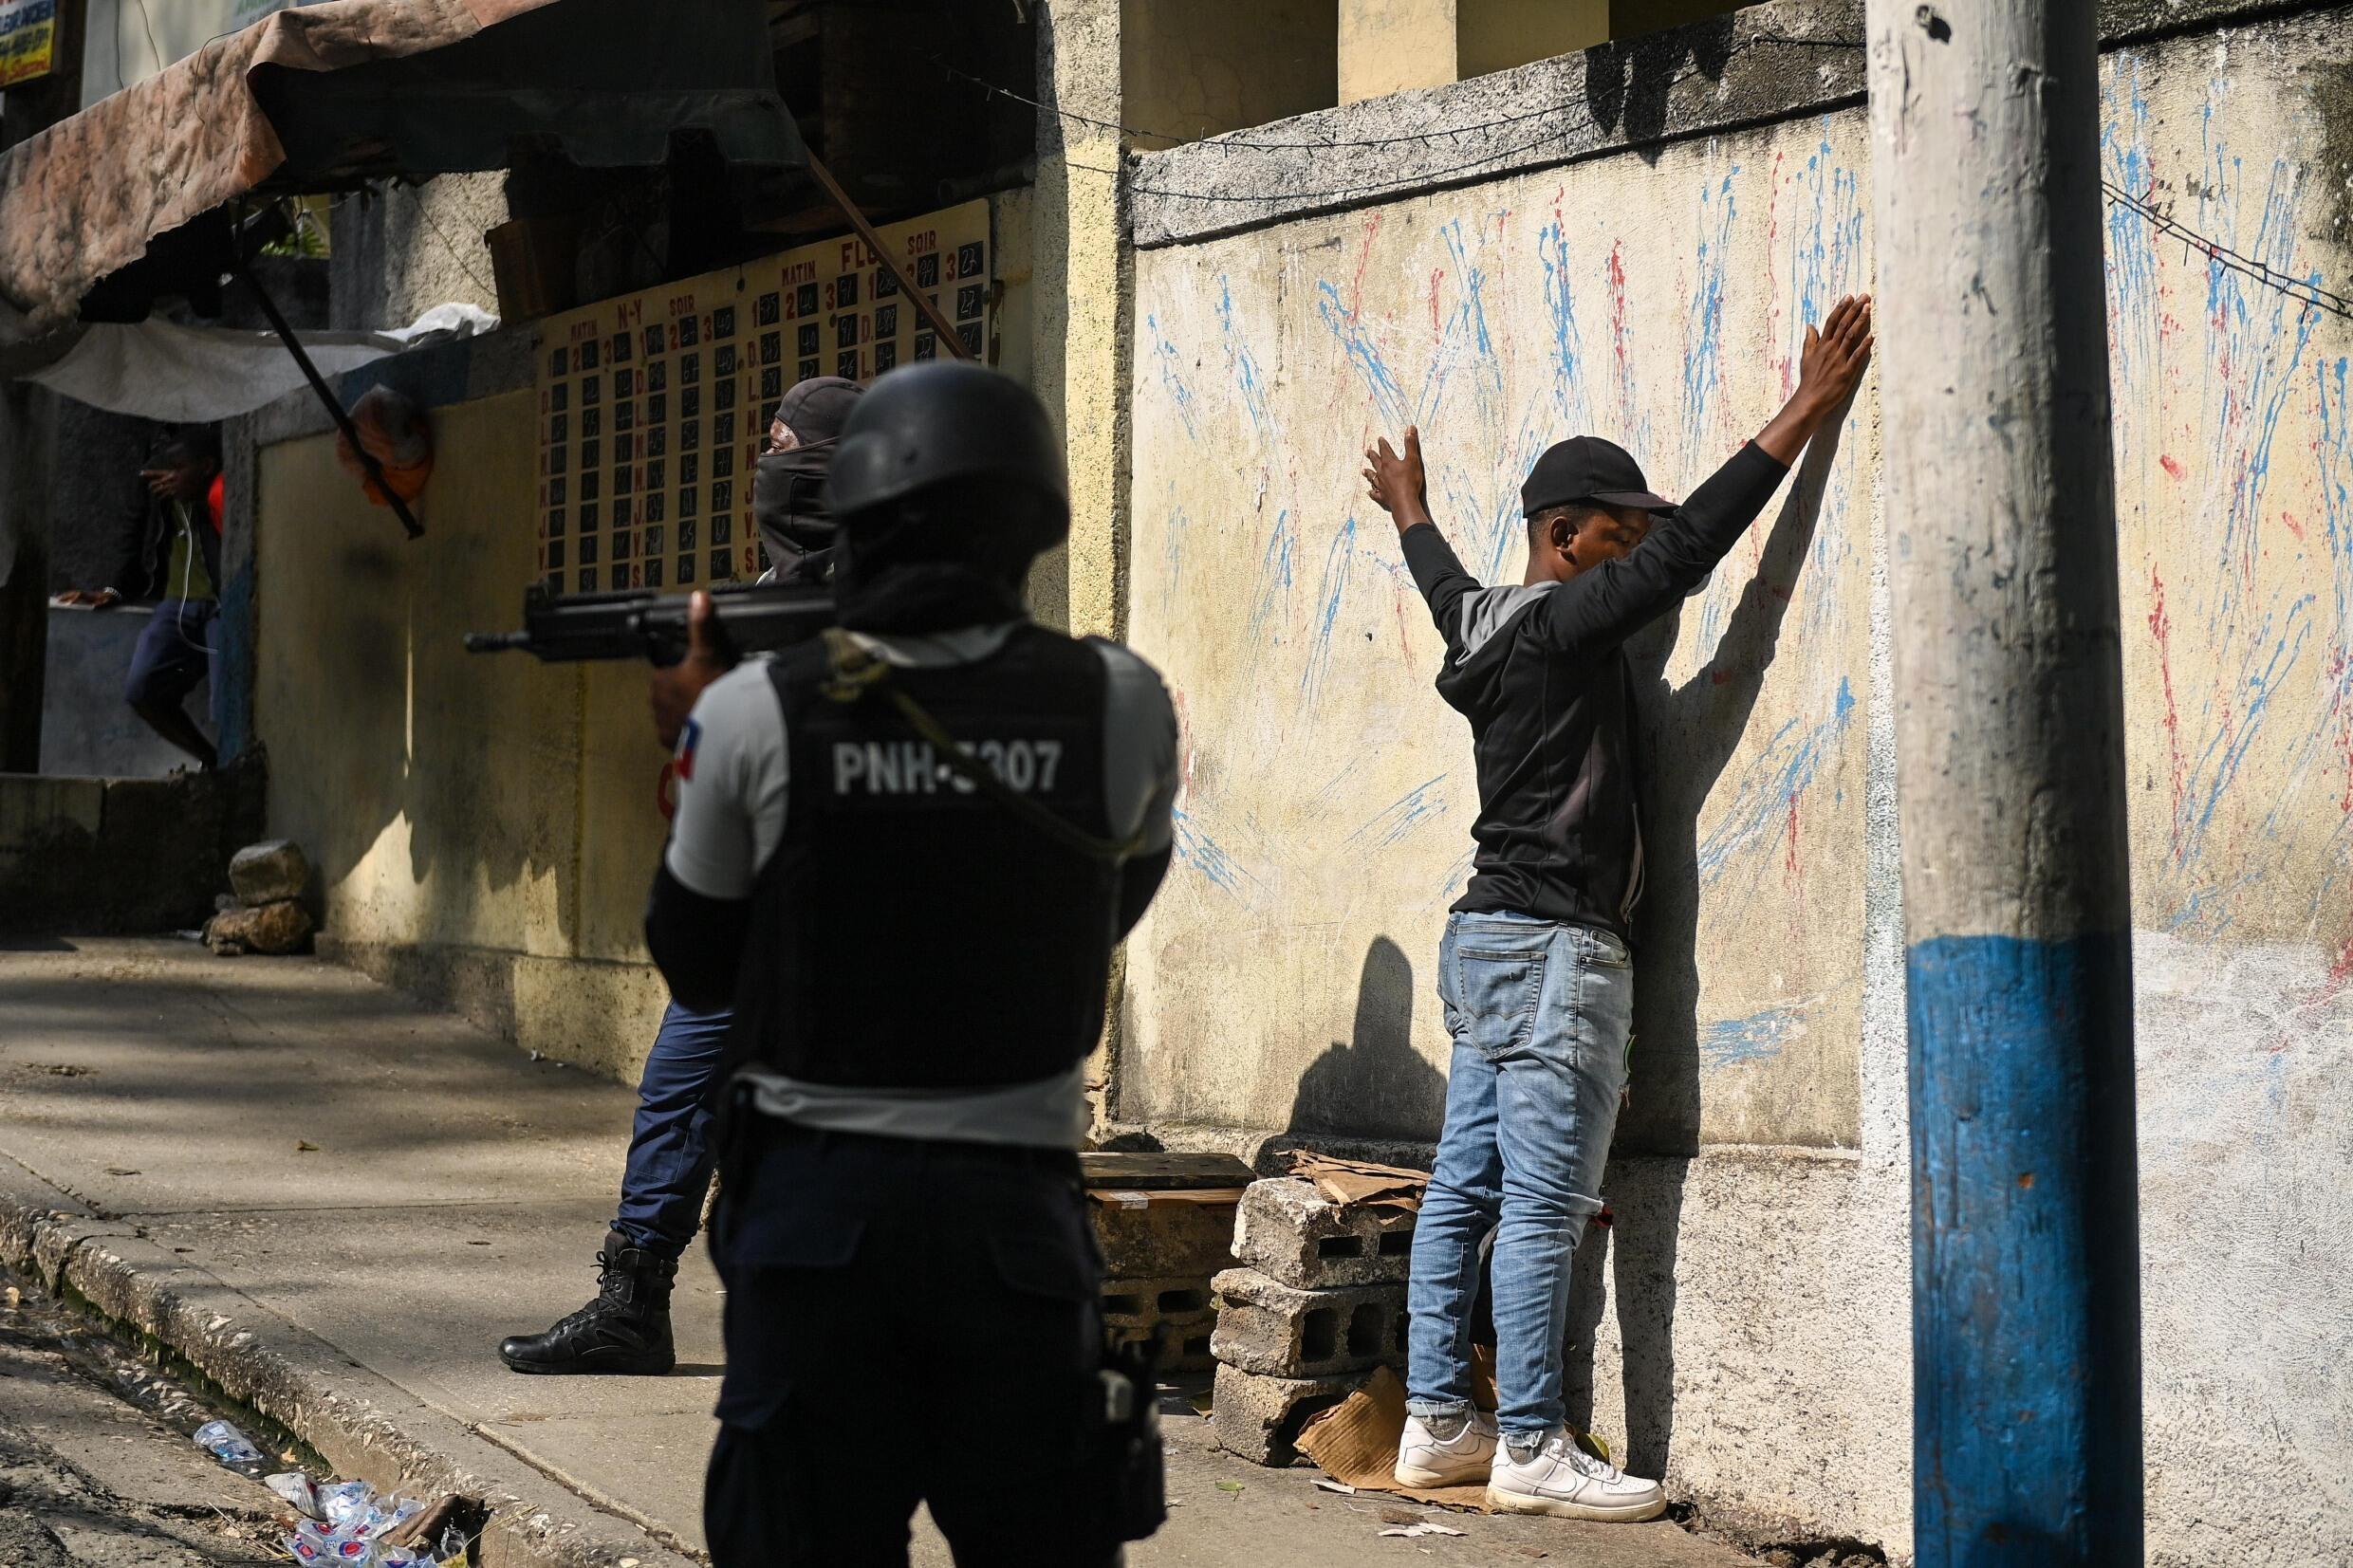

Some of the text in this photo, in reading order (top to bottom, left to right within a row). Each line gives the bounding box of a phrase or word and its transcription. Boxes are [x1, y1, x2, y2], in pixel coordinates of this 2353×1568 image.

[907, 230, 936, 255] SOIR
[782, 261, 816, 286] MATIN
[947, 253, 955, 281] 3
[867, 273, 875, 301] 1
[618, 298, 642, 329] N-Y
[670, 294, 695, 317] SOIR
[752, 283, 835, 328] 1 2 3
[571, 319, 598, 342] MATIN
[639, 331, 646, 358] 1
[670, 324, 678, 350] 2
[704, 316, 713, 342] 3
[573, 347, 581, 373] 2
[604, 340, 612, 364] 3
